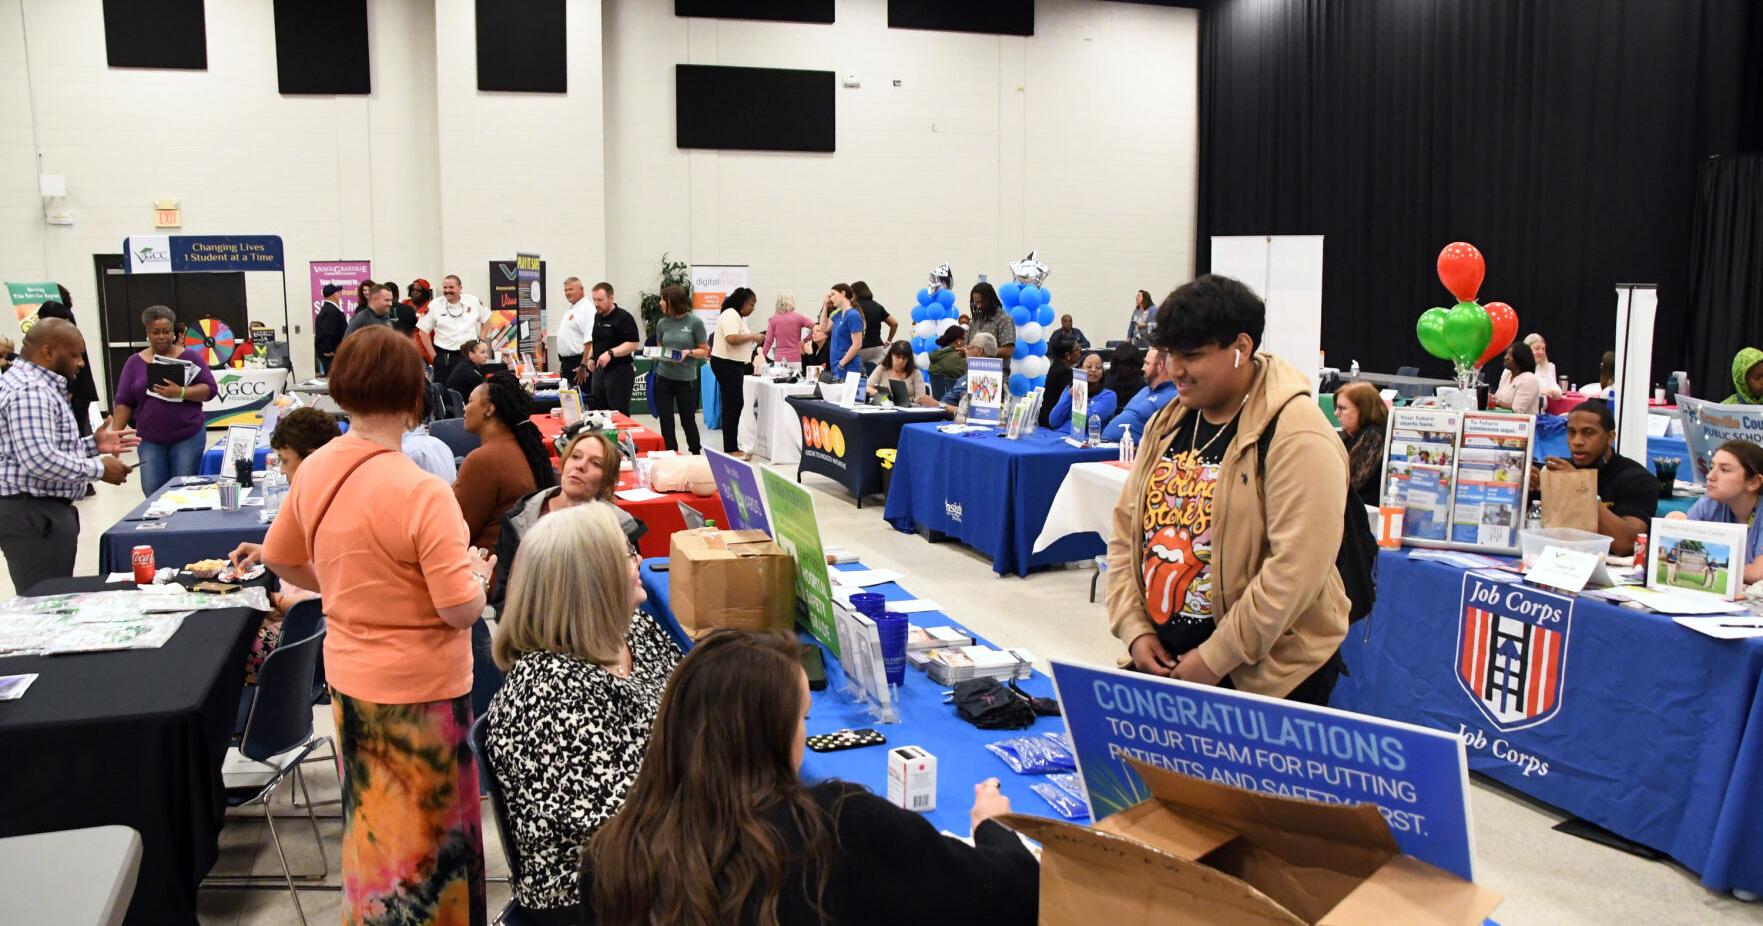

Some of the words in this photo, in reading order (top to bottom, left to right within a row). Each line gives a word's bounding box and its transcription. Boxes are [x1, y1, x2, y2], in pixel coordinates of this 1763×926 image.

[159, 211, 176, 225] EXIT
[191, 254, 228, 262] Student
[230, 254, 240, 262] at
[251, 254, 274, 262] Time
[192, 243, 237, 253] Changing
[240, 243, 265, 251] Lives
[969, 361, 1001, 369] PREVENTION
[1742, 415, 1763, 430] Cou
[1470, 581, 1500, 605] Job
[1505, 592, 1563, 625] Corps
[1093, 680, 1407, 772] CONGRATULATIONS
[1106, 716, 1136, 739] TO
[1139, 725, 1186, 750] OUR
[1185, 734, 1252, 766] TEAM
[1255, 749, 1304, 778] FOR
[1306, 760, 1418, 804] PUTTING
[1457, 723, 1487, 749] Job
[1492, 738, 1550, 777] Corps
[1108, 743, 1207, 780] PATIENTS
[1210, 768, 1258, 794] AND
